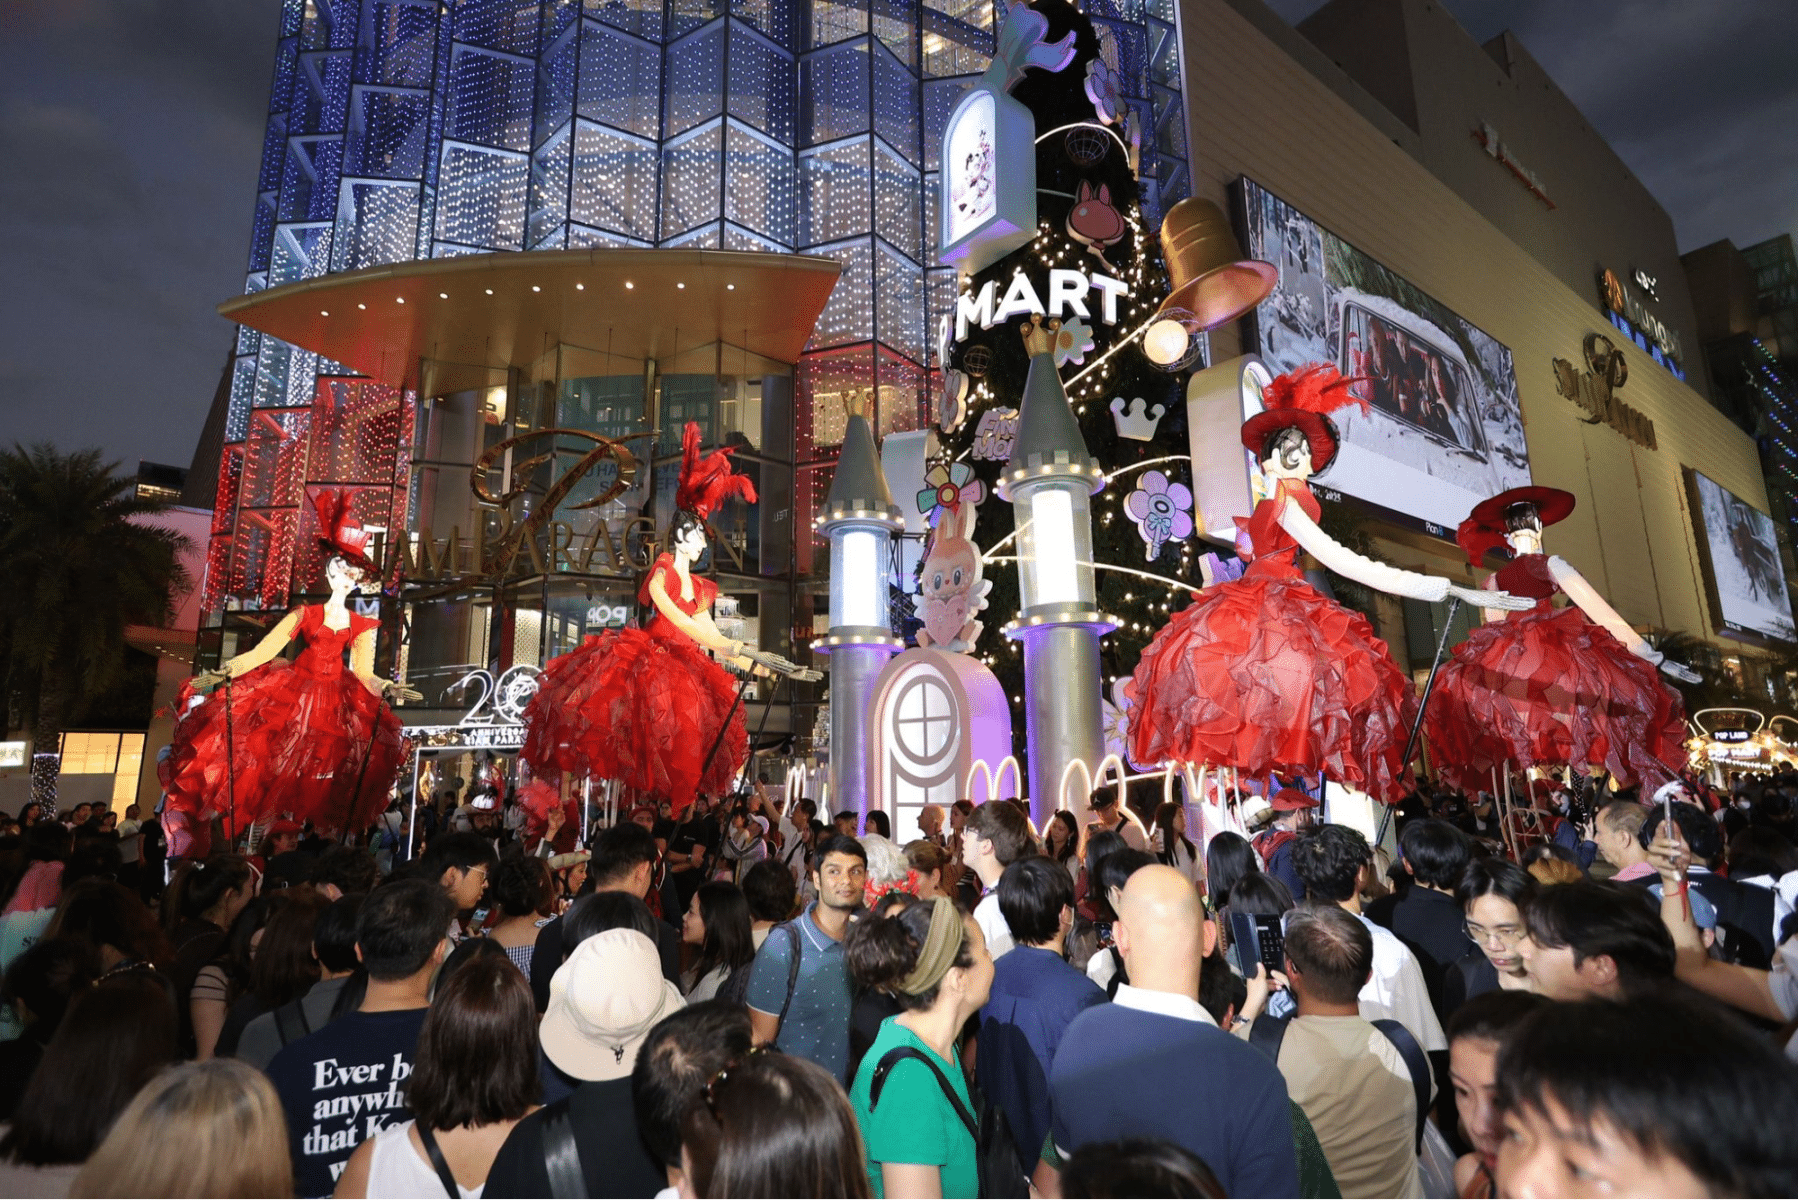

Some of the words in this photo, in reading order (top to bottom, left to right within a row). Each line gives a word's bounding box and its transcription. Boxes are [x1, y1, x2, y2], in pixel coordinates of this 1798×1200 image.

[955, 268, 1129, 343] MART
[975, 410, 1017, 437] FIN
[371, 524, 461, 583] IAM
[470, 727, 526, 737] ANNIVERSA
[493, 735, 524, 745] PARA
[312, 1058, 385, 1090] Ever
[313, 1081, 411, 1125] anywh
[303, 1124, 358, 1155] that
